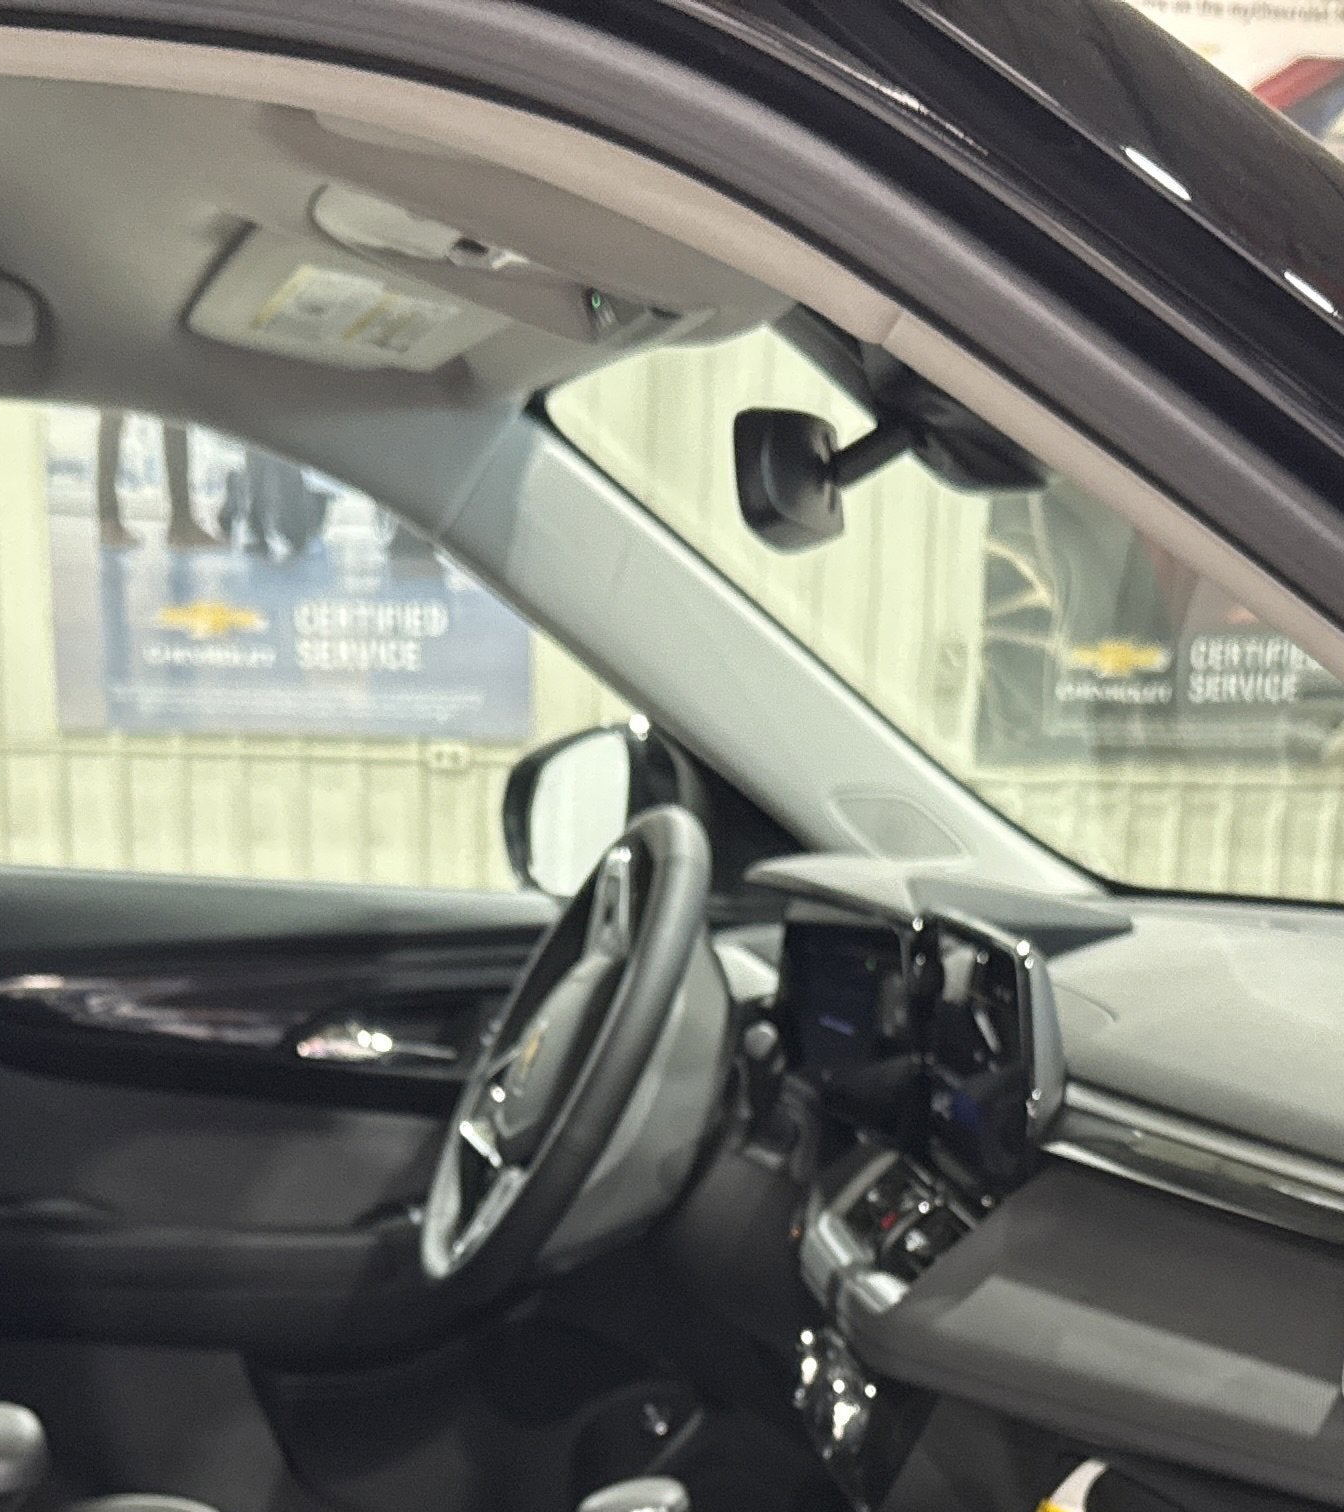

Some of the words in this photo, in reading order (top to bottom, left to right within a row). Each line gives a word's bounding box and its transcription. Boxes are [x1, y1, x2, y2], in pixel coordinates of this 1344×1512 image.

[295, 638, 423, 671] SERVICE
[1190, 637, 1322, 671] CERTIFIE
[1188, 672, 1297, 703] SERVICE
